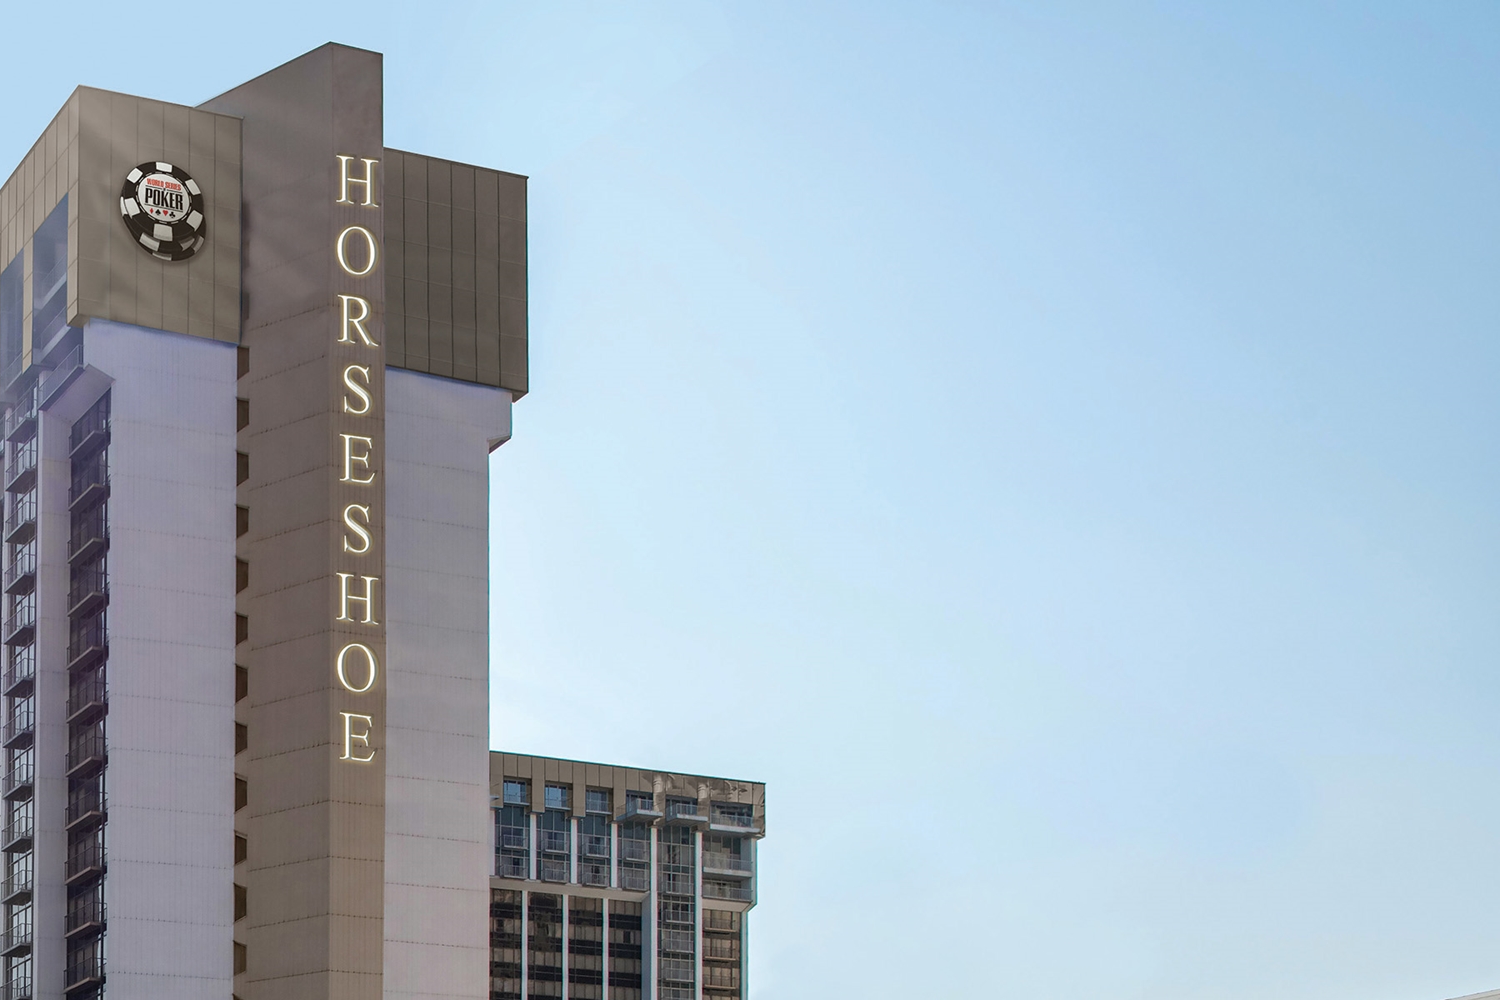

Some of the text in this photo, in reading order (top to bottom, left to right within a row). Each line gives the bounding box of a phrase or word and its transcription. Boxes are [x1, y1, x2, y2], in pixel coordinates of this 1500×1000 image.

[147, 178, 164, 187] WORLD
[165, 182, 181, 190] SERIES
[145, 187, 183, 210] POKER
[336, 154, 380, 763] HORSESHOE
